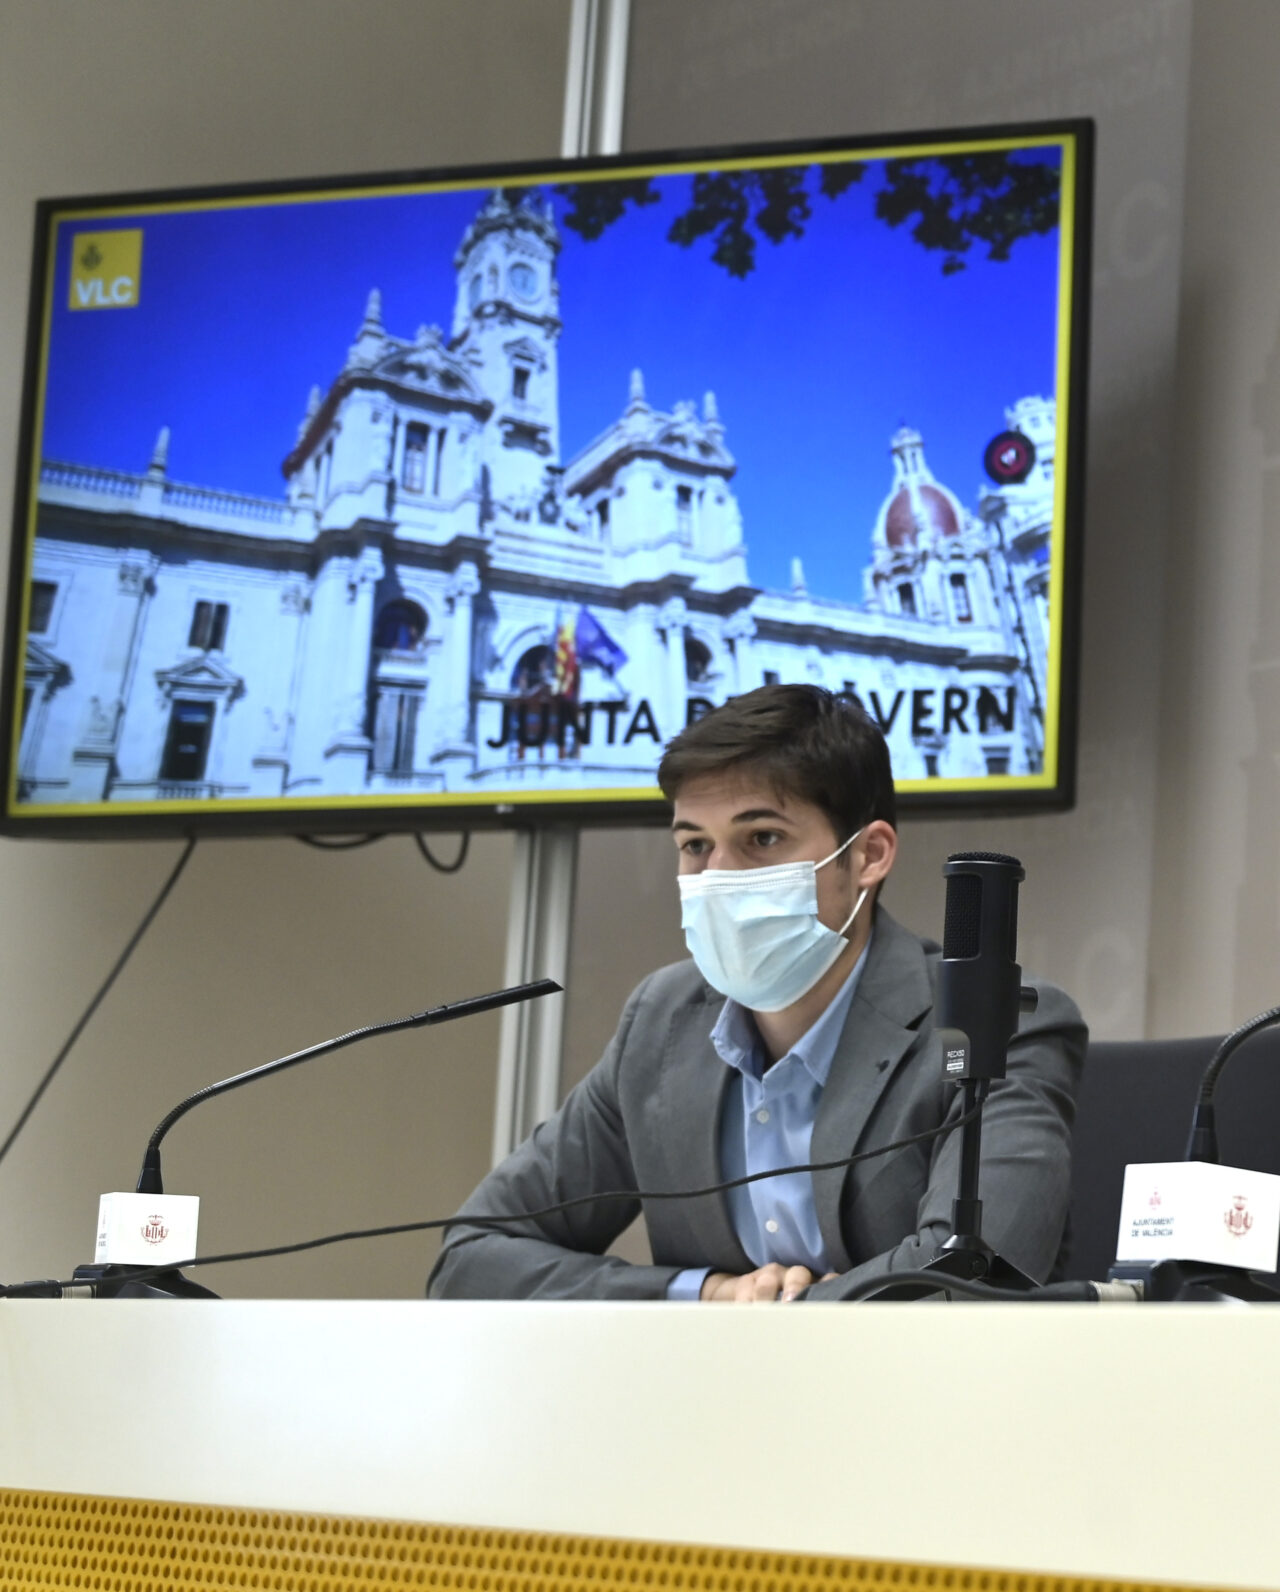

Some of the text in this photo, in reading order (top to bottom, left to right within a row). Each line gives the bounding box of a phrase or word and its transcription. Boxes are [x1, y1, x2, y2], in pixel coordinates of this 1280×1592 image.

[75, 275, 133, 306] VLC
[487, 698, 661, 749] JUNTA
[834, 686, 1017, 736] VERN
